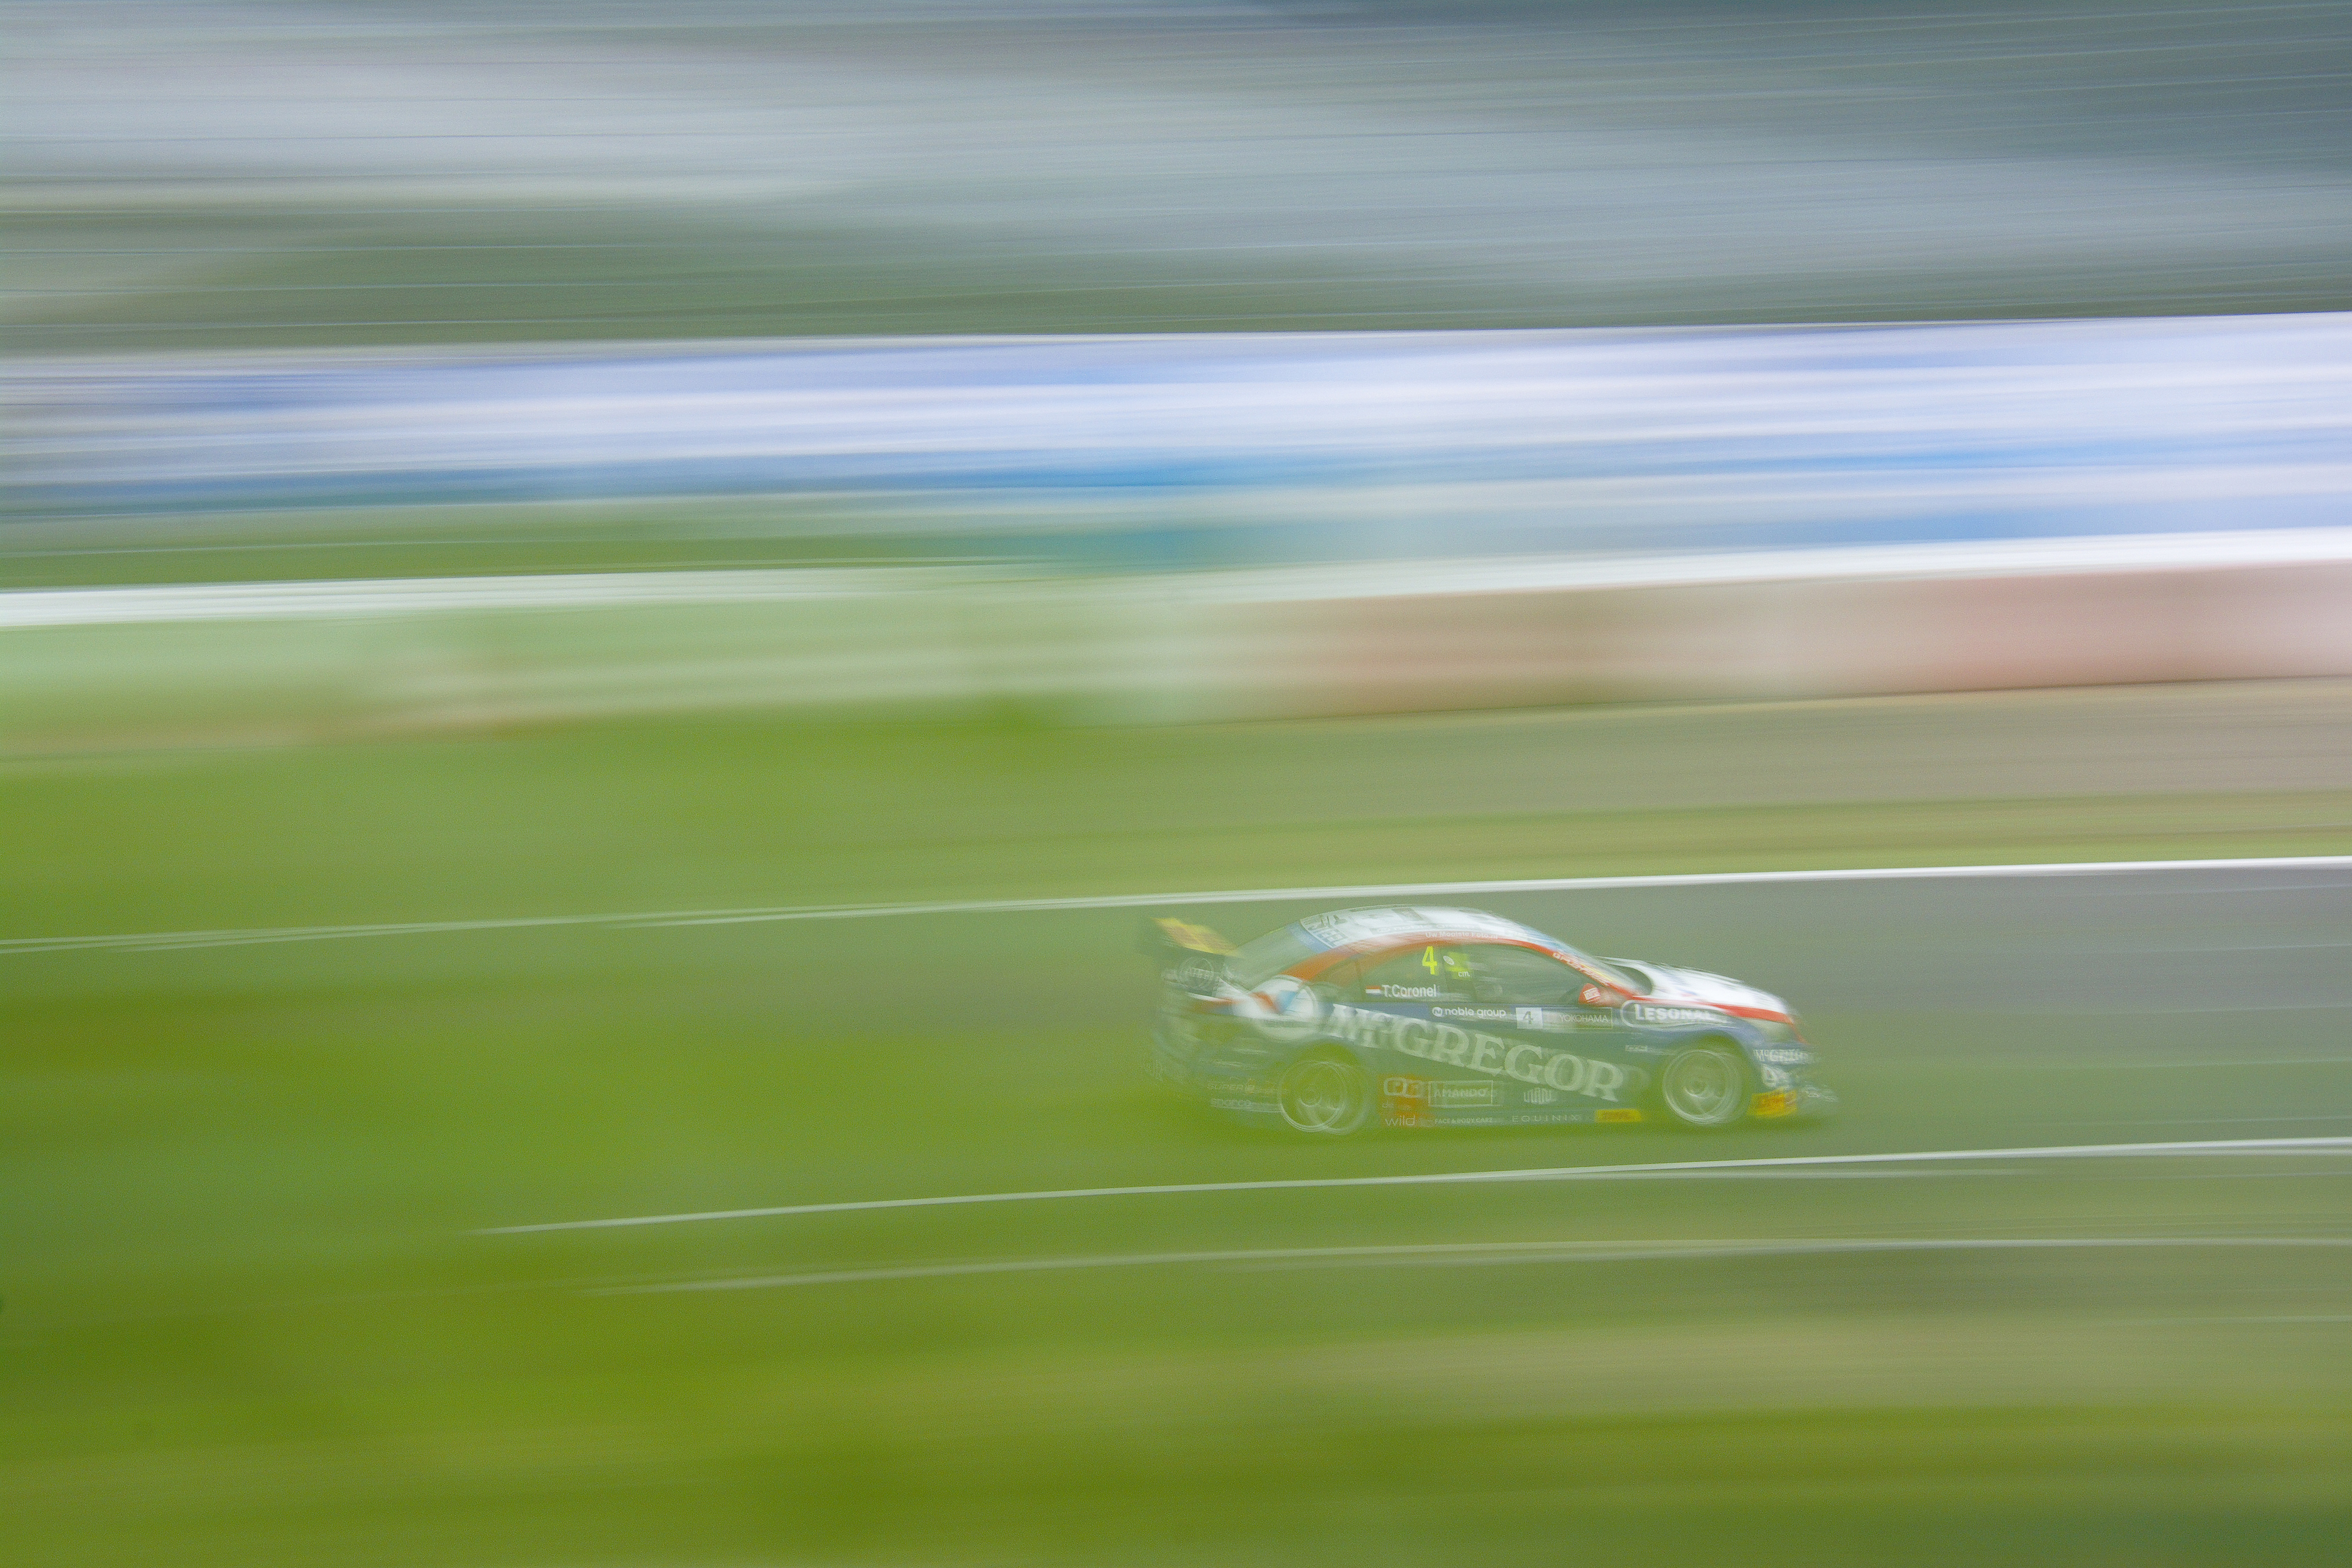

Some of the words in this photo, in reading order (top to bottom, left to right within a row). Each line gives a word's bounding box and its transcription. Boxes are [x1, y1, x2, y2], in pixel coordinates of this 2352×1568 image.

[1422, 946, 1437, 975] 4
[1382, 984, 1436, 998] T.Coronel
[1445, 1007, 1475, 1016] noble
[1477, 1009, 1506, 1018] group
[1519, 1011, 1534, 1025] 4
[1560, 1013, 1608, 1022] YOKOHAMA
[1385, 1114, 1415, 1126] wild
[1512, 1114, 1578, 1123] EQUINIX
